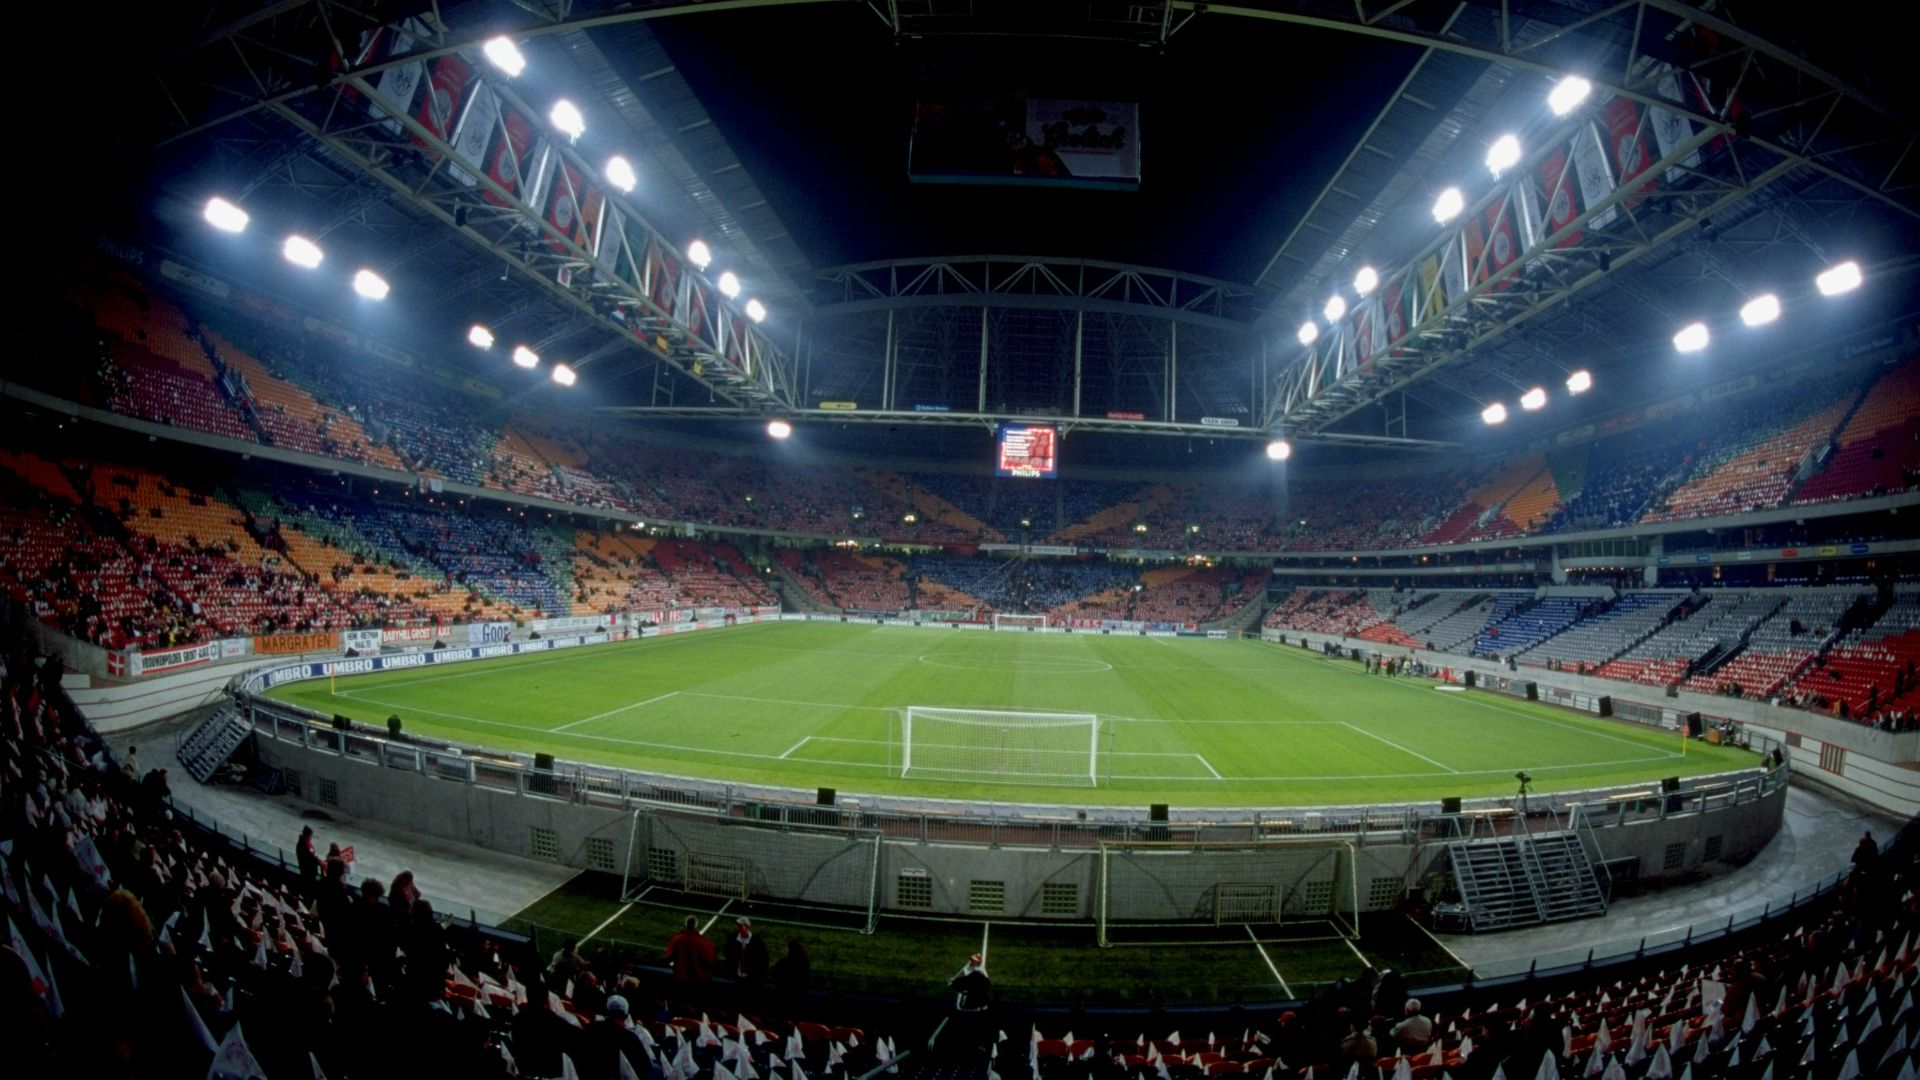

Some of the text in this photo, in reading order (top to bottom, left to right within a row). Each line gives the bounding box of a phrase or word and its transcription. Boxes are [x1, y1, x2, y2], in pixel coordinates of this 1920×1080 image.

[1011, 469, 1040, 477] PHILIPS
[262, 635, 331, 653] MARGRATEN
[479, 644, 513, 657] UMBRO
[519, 640, 549, 652] UMBRO
[382, 653, 426, 668] UMBRO
[433, 648, 472, 663] UMBRO
[268, 664, 312, 685] UMBRO
[322, 659, 373, 675] UMBRO
